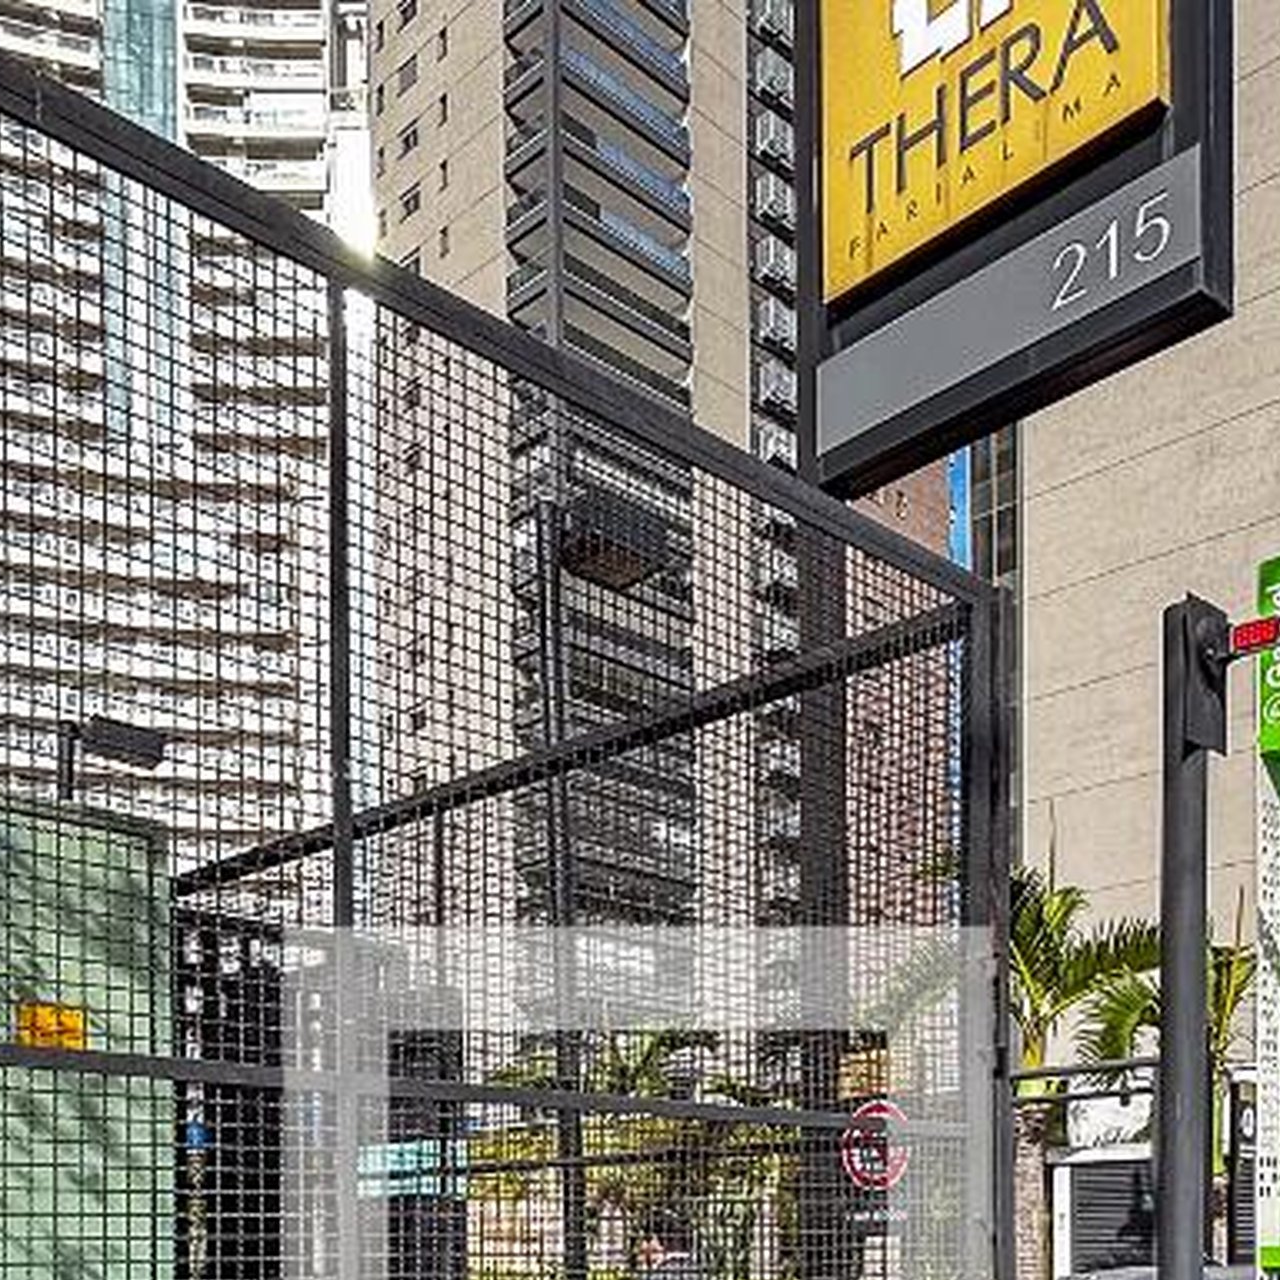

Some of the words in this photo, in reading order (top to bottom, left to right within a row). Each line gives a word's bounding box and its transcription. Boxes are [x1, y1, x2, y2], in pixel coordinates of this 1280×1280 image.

[849, 0, 1120, 214] THERA
[849, 166, 975, 260] FARIA
[1051, 189, 1172, 310] 215
